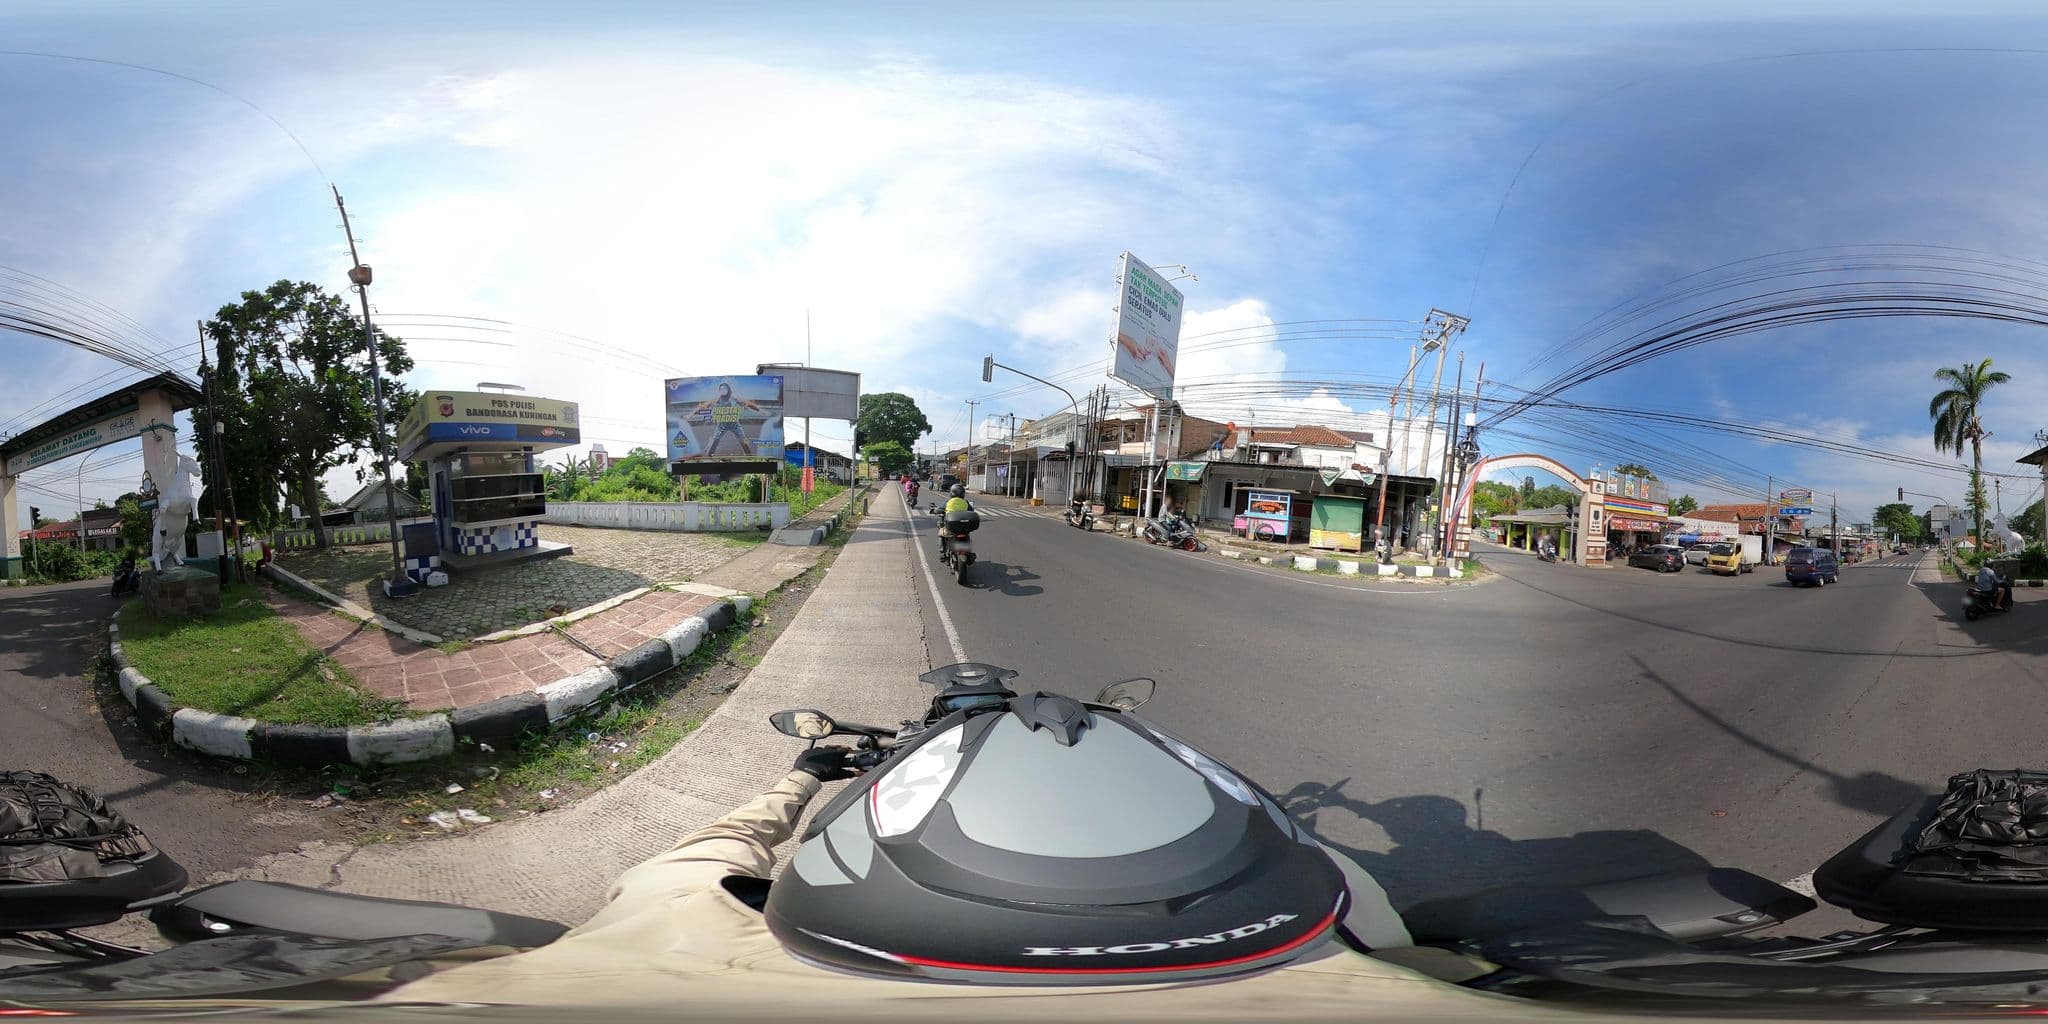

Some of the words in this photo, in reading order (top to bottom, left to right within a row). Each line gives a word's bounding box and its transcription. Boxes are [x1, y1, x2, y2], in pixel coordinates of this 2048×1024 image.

[491, 400, 508, 408] POS
[466, 409, 518, 418] BANDORASA
[519, 411, 557, 420] KUNINGAN
[459, 424, 491, 434] vivo
[30, 441, 60, 458] SELAMAT
[62, 428, 97, 445] DATANG
[1022, 913, 1298, 956] HONDA
